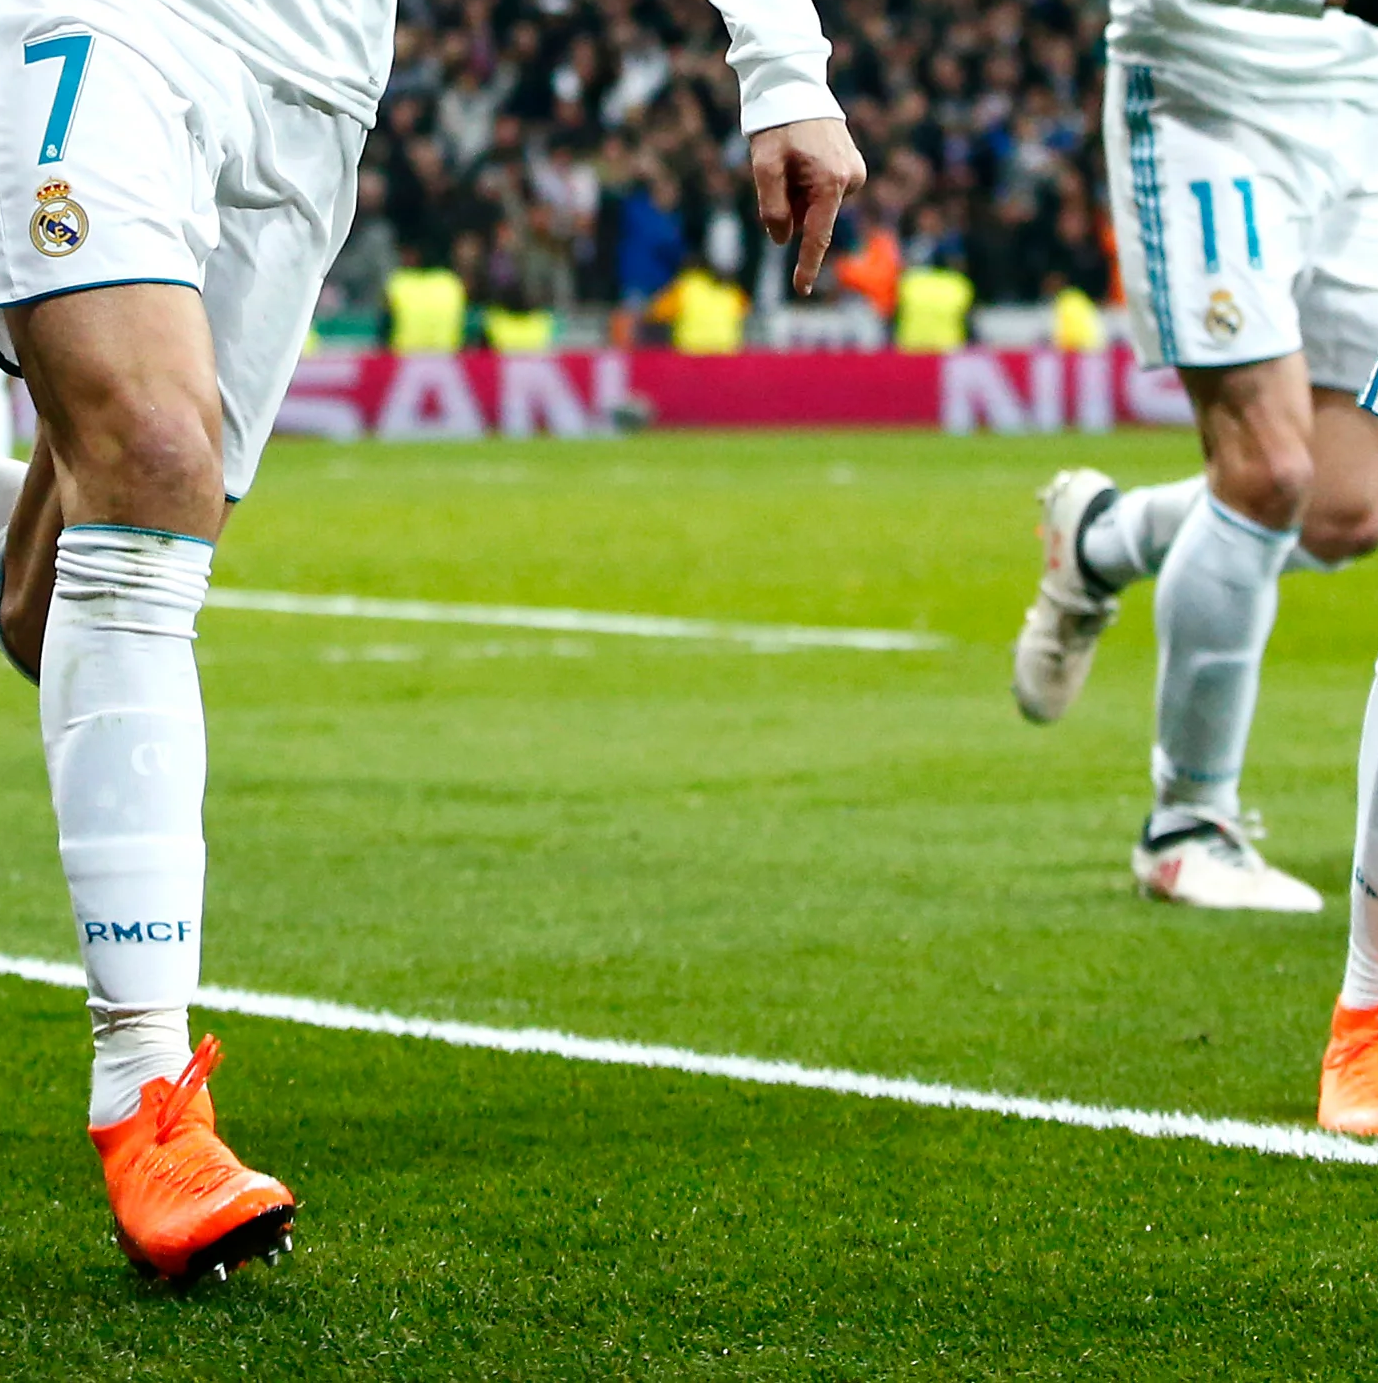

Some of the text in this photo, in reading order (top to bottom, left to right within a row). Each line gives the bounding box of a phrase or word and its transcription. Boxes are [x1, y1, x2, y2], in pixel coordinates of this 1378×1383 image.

[23, 31, 96, 166] 7
[1188, 177, 1264, 274] 11
[84, 920, 192, 945] RMCF
